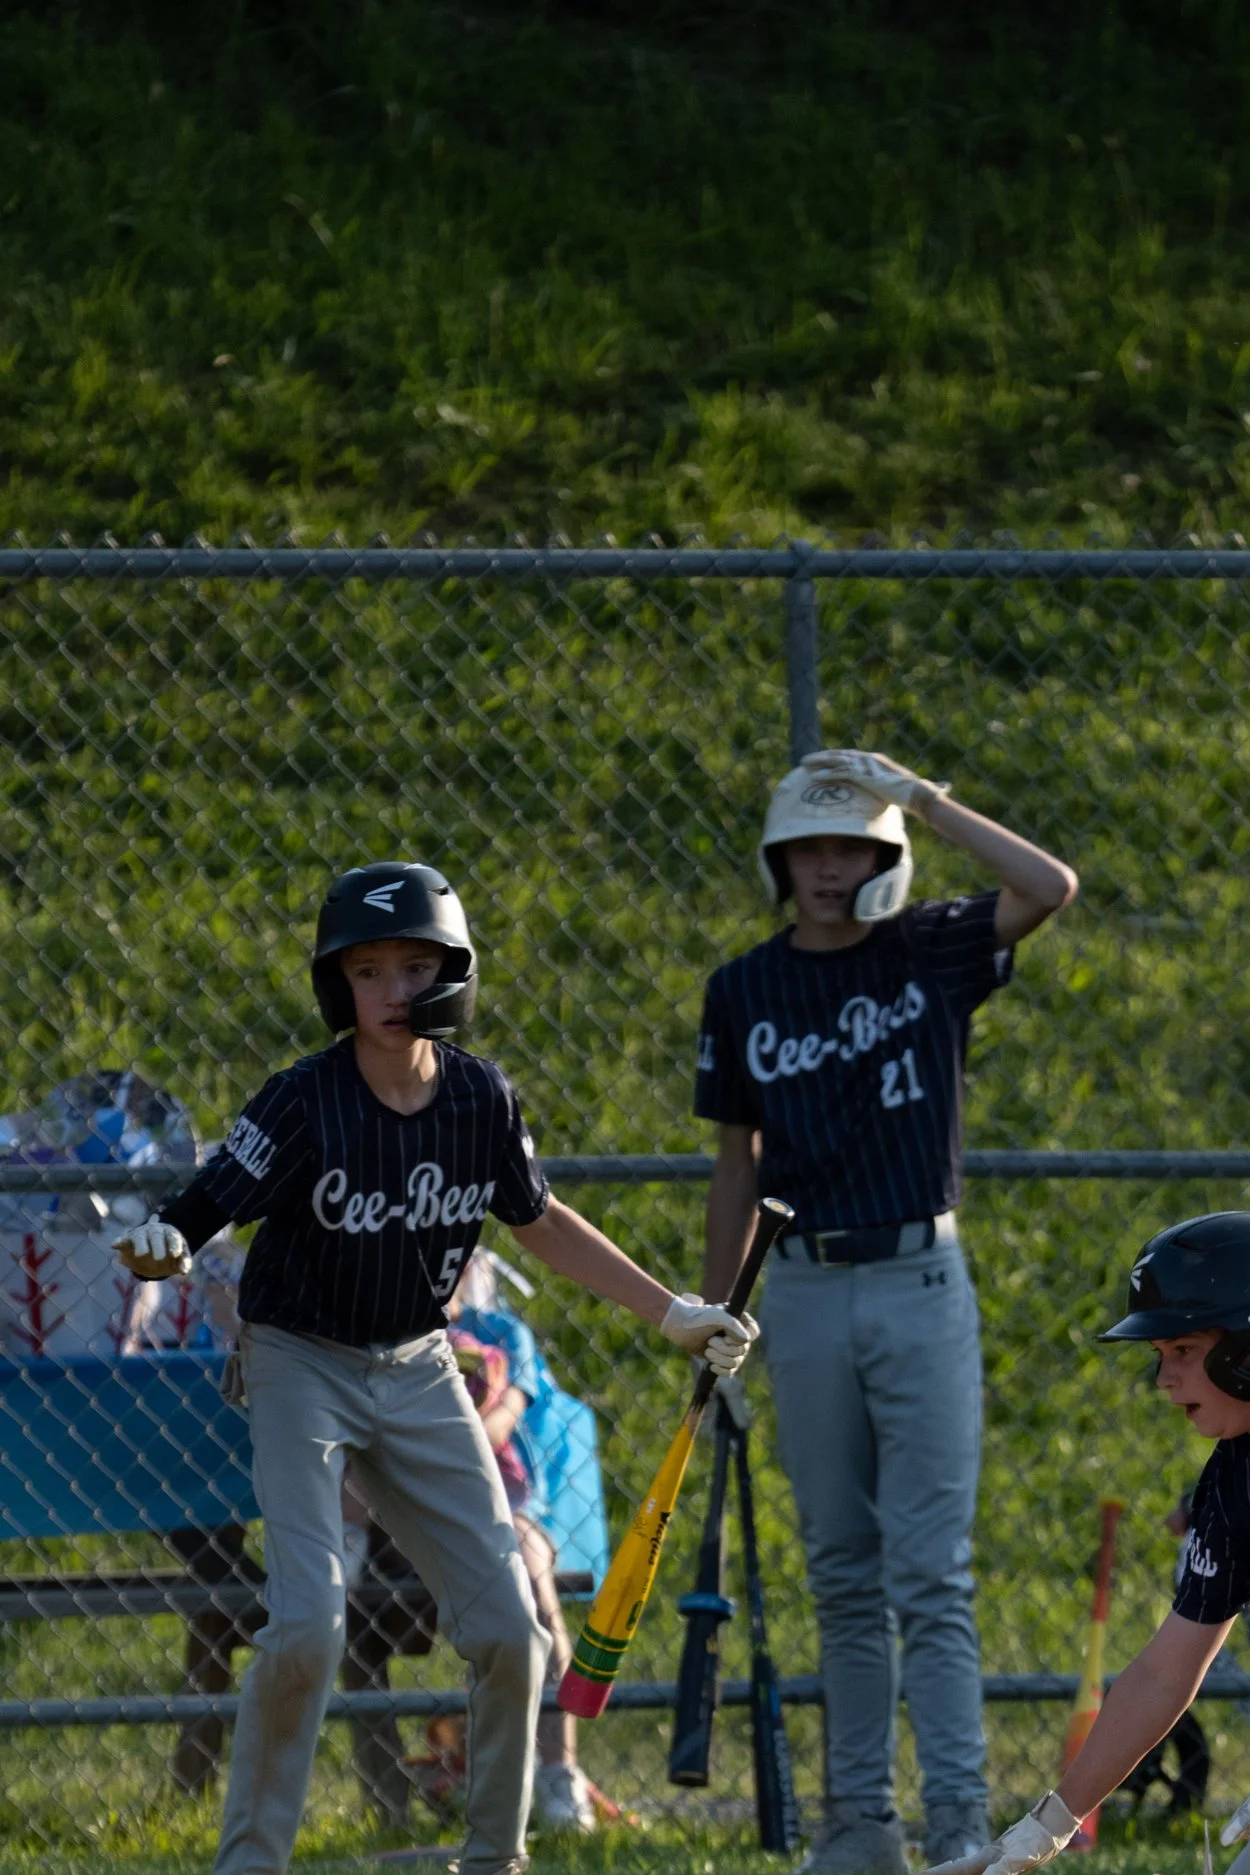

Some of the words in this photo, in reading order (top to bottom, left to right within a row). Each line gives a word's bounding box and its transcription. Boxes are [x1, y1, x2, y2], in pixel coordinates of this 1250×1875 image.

[880, 1049, 924, 1109] 21
[312, 1162, 496, 1234] Cee-Bees
[434, 1246, 464, 1297] 5
